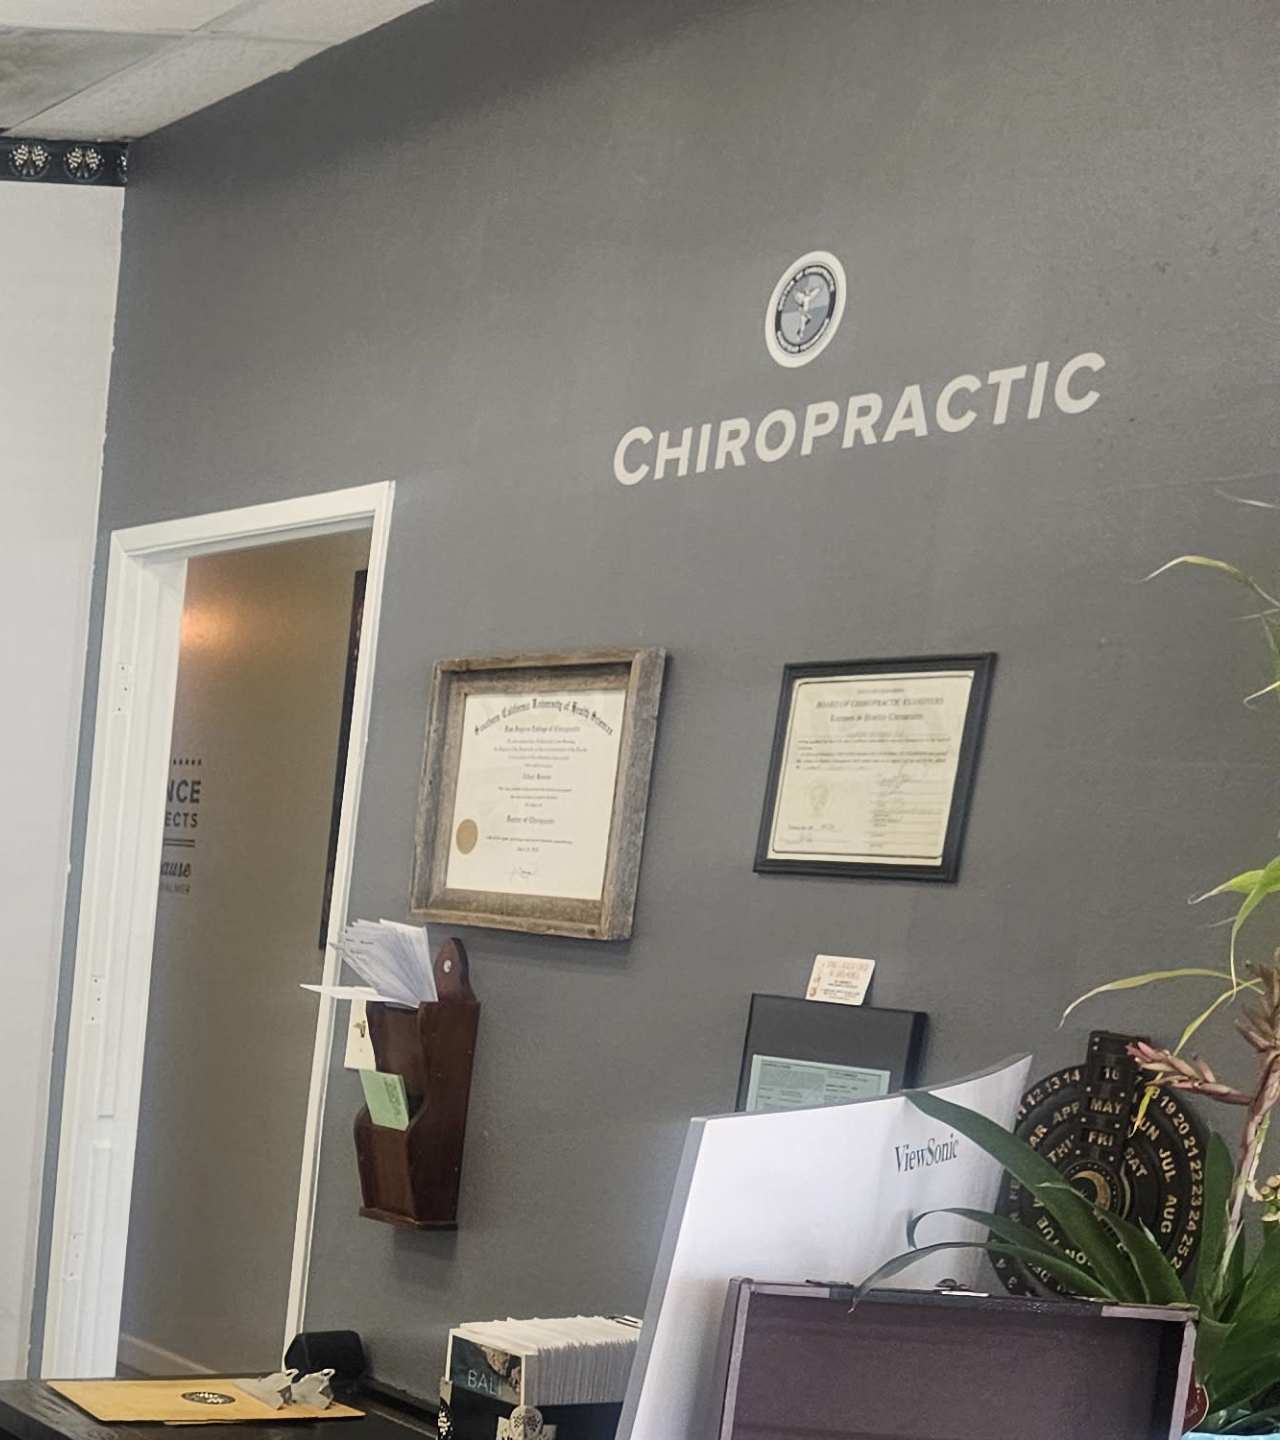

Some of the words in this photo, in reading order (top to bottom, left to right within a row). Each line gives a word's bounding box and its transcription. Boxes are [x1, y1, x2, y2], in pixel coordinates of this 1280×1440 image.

[612, 352, 1106, 486] CHIROPRACTIC
[166, 779, 201, 803] NCE
[164, 811, 198, 828] ECTS
[1063, 1069, 1081, 1083] 14
[1090, 1098, 1123, 1114] MAY
[1159, 1095, 1176, 1114] 19
[1172, 1113, 1190, 1135] 20
[1088, 1131, 1114, 1146] FRI
[1183, 1136, 1199, 1157] 21
[892, 1134, 961, 1174] ViewSonic
[1159, 1148, 1176, 1183] JUL
[1190, 1160, 1202, 1180] 22
[1191, 1185, 1203, 1207] 23
[1160, 1194, 1178, 1233] AUG
[1186, 1211, 1200, 1231] 24
[1177, 1234, 1193, 1256] 25
